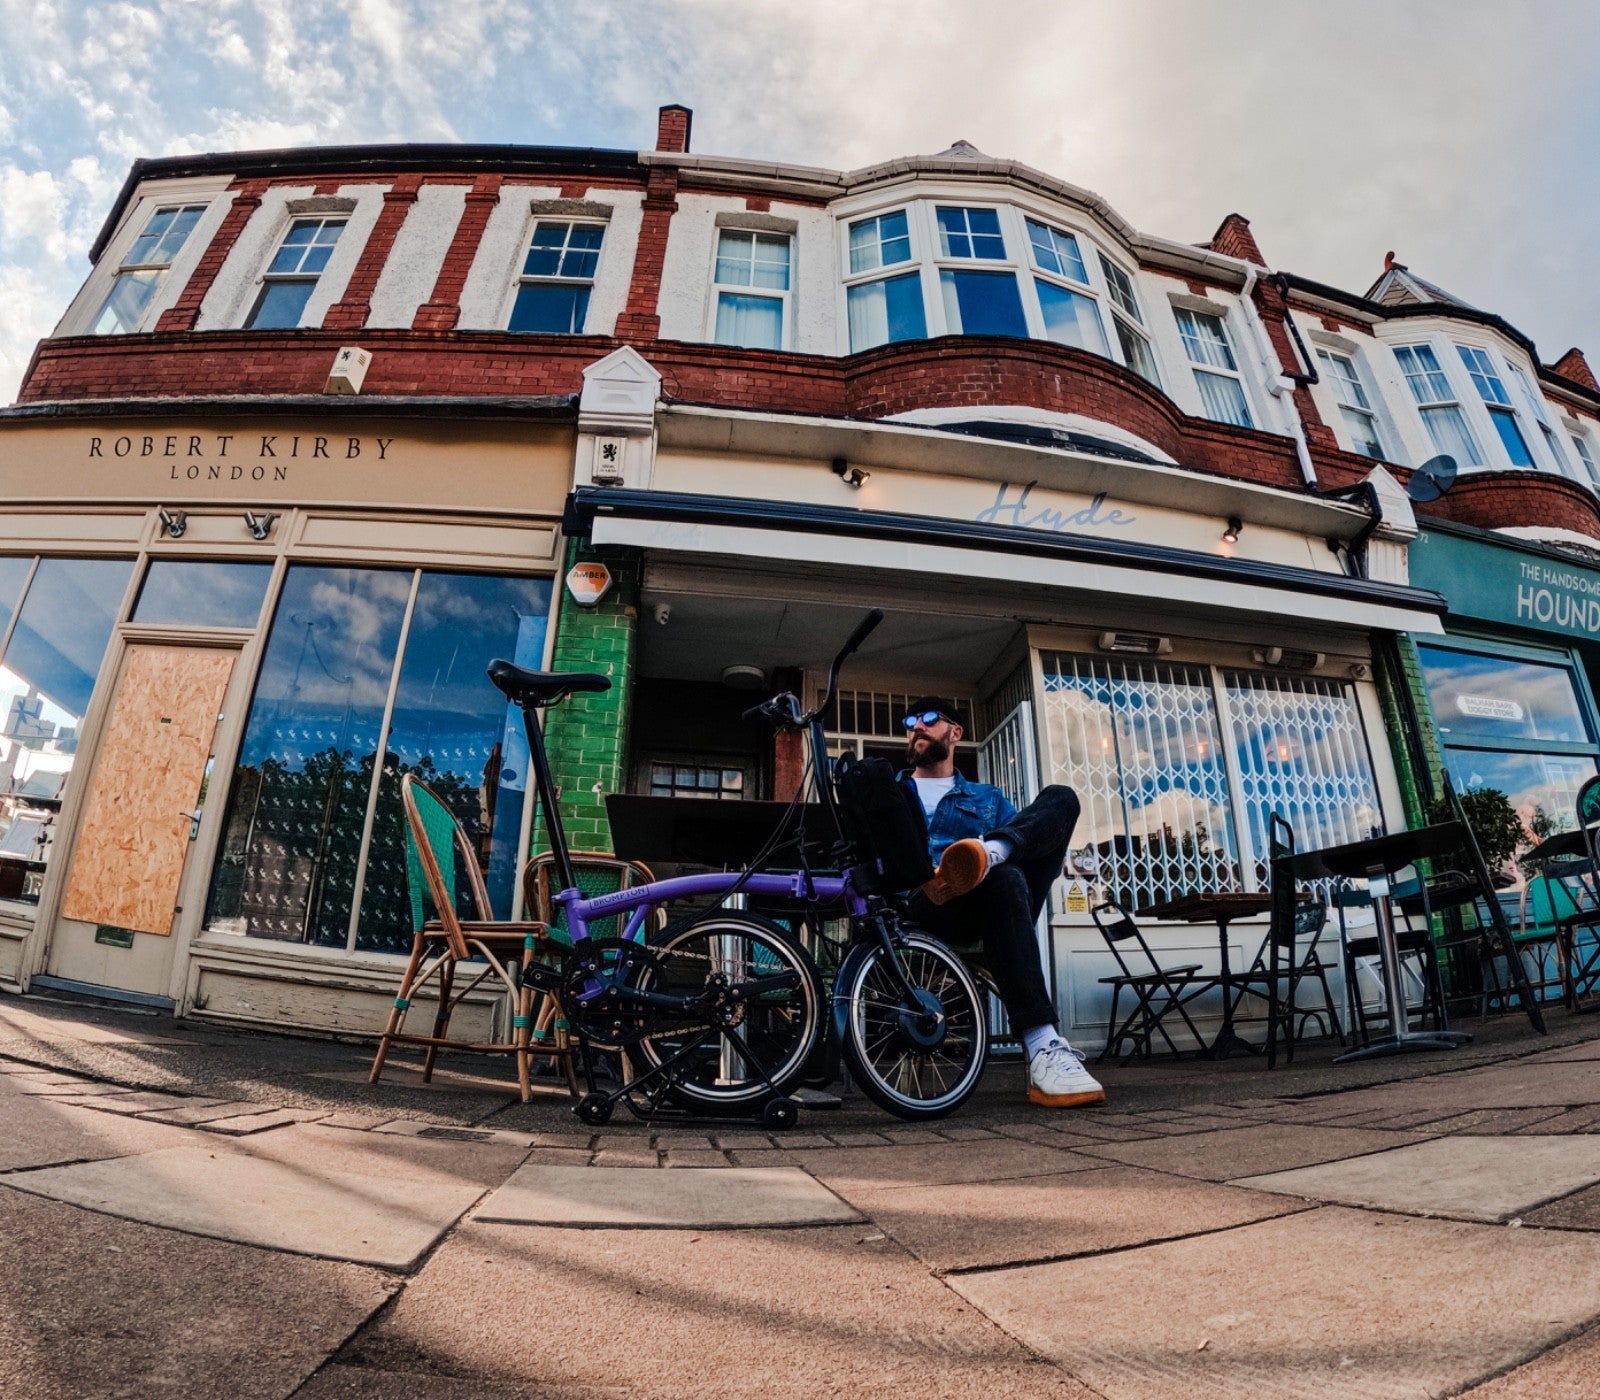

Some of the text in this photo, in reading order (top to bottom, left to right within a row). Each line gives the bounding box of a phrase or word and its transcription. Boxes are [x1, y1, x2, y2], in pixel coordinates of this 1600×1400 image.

[89, 436, 394, 459] ROBERT KIRBY
[170, 465, 288, 481] LONDON
[976, 480, 1136, 530] Hyde
[573, 571, 606, 579] AMBER
[1520, 562, 1600, 596] THE HANDSOME
[1517, 584, 1600, 632] HOUND
[593, 888, 645, 906] BROMPTON
